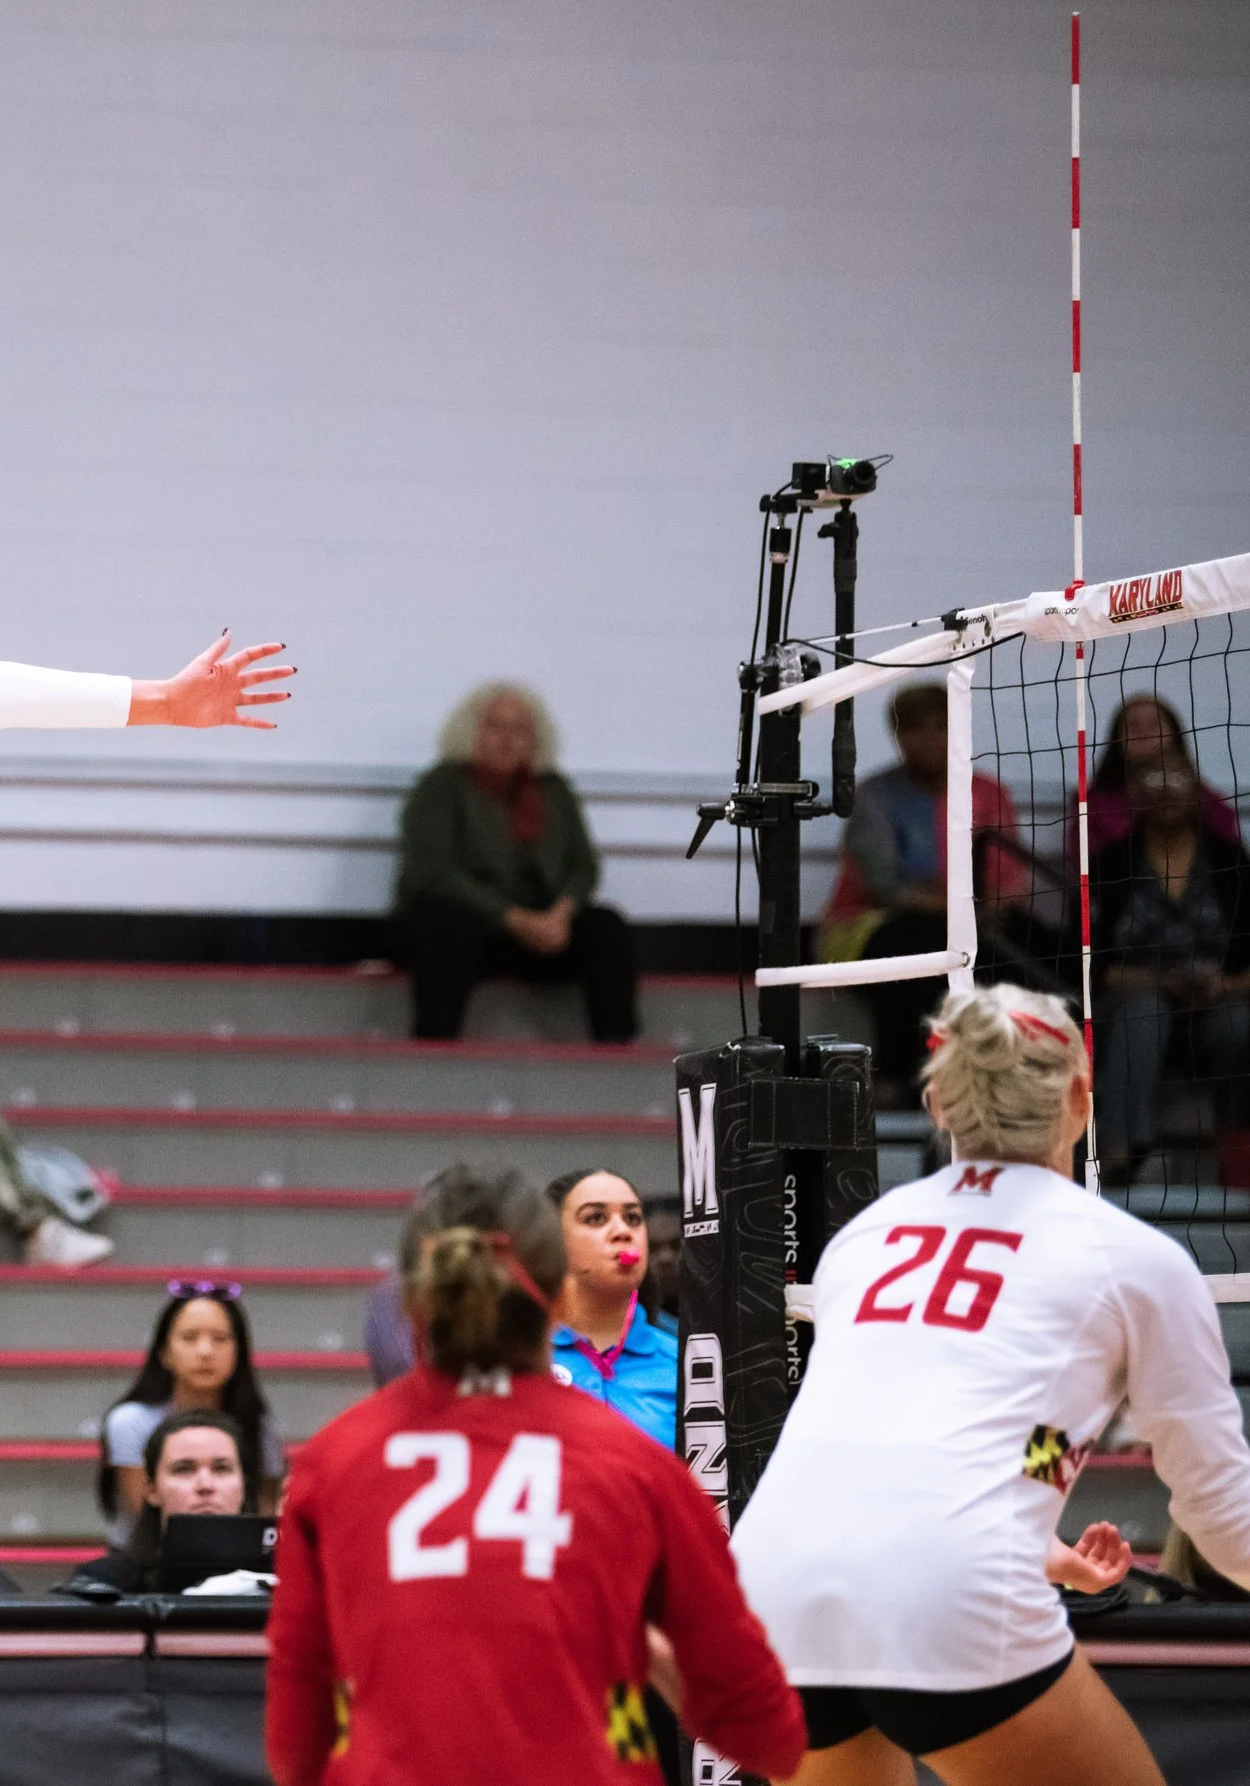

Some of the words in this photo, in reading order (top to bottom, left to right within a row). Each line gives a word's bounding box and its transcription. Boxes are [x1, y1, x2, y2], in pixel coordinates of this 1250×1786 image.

[1107, 569, 1183, 618] MARYLAND
[678, 1083, 719, 1219] M
[951, 1165, 1006, 1195] M
[854, 1225, 1024, 1333] 26
[384, 1431, 573, 1583] 24
